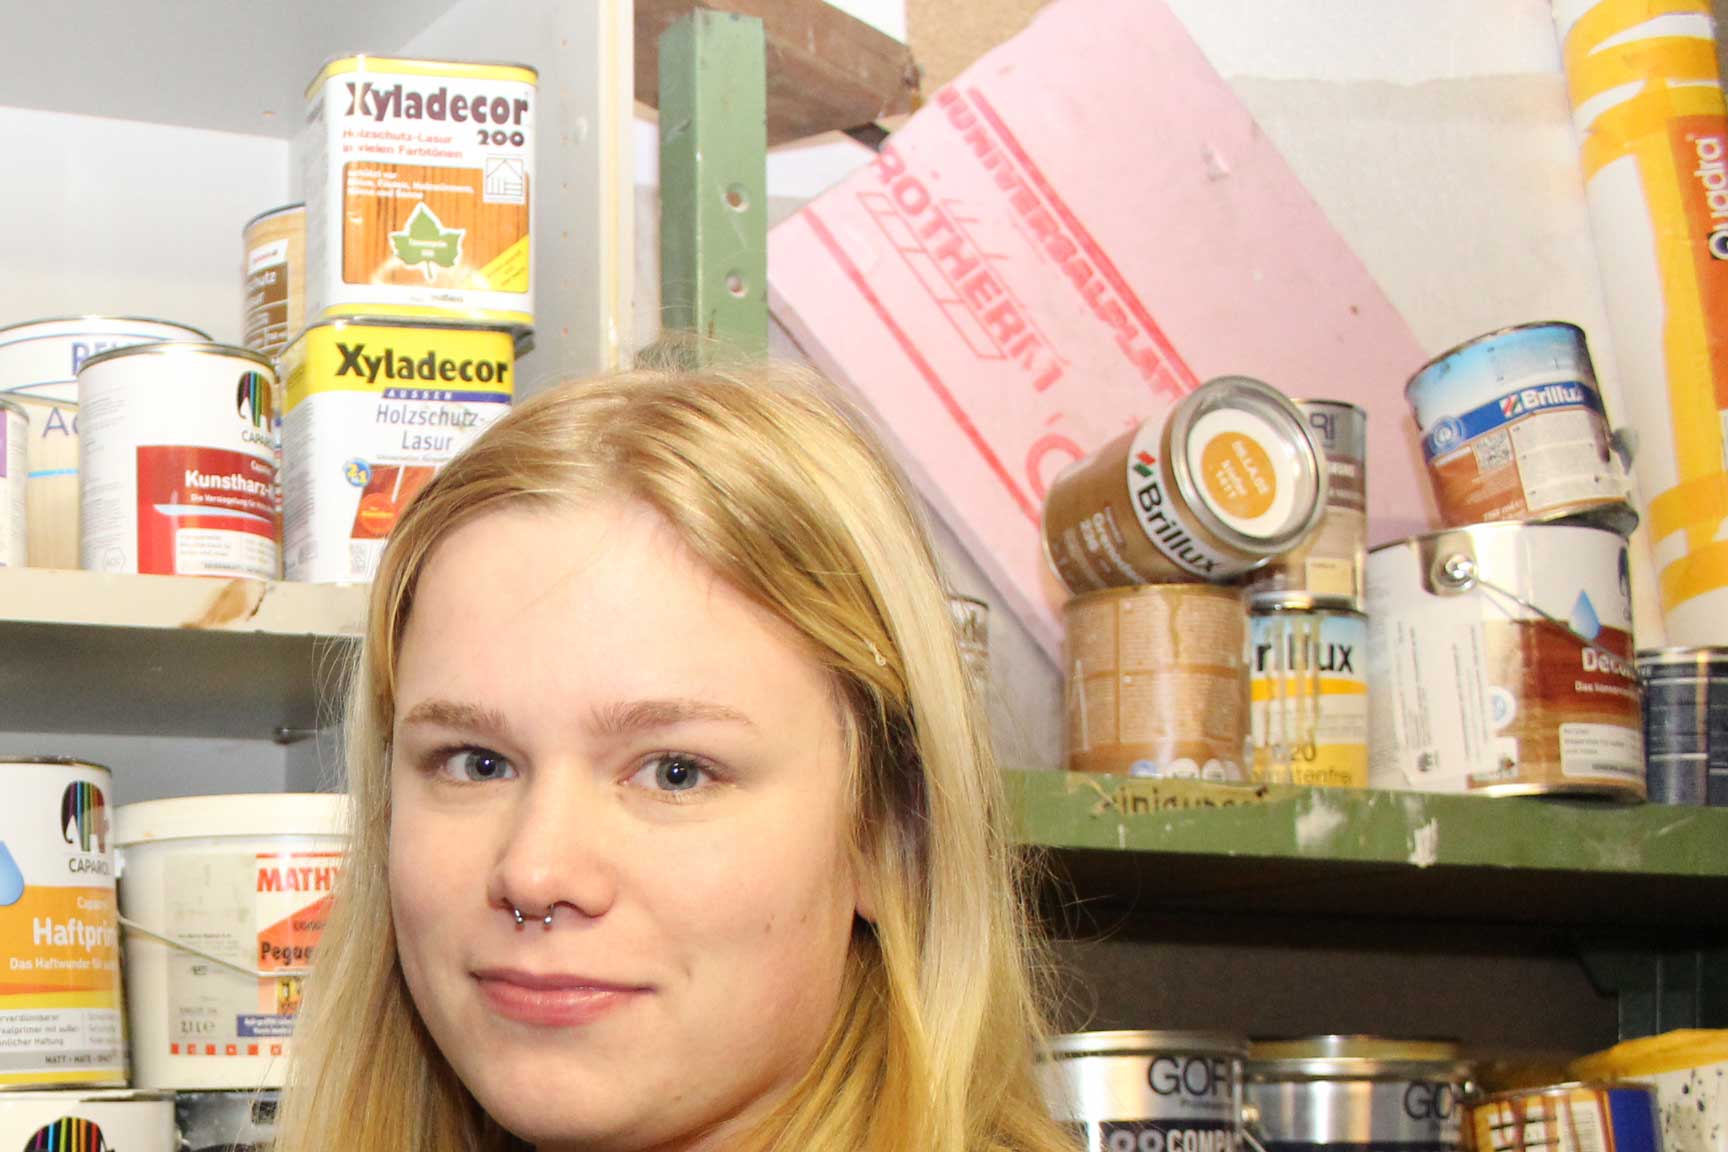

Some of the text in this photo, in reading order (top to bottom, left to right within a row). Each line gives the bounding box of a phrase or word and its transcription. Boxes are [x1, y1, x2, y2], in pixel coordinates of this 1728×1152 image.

[344, 82, 529, 126] Xyladecor
[477, 129, 525, 147] 200
[335, 342, 508, 384] Xyladecor
[376, 404, 485, 428] Holzschutz-
[401, 431, 453, 451] Lasur
[1138, 480, 1220, 574] Brillux
[1404, 1080, 1458, 1120] GO
